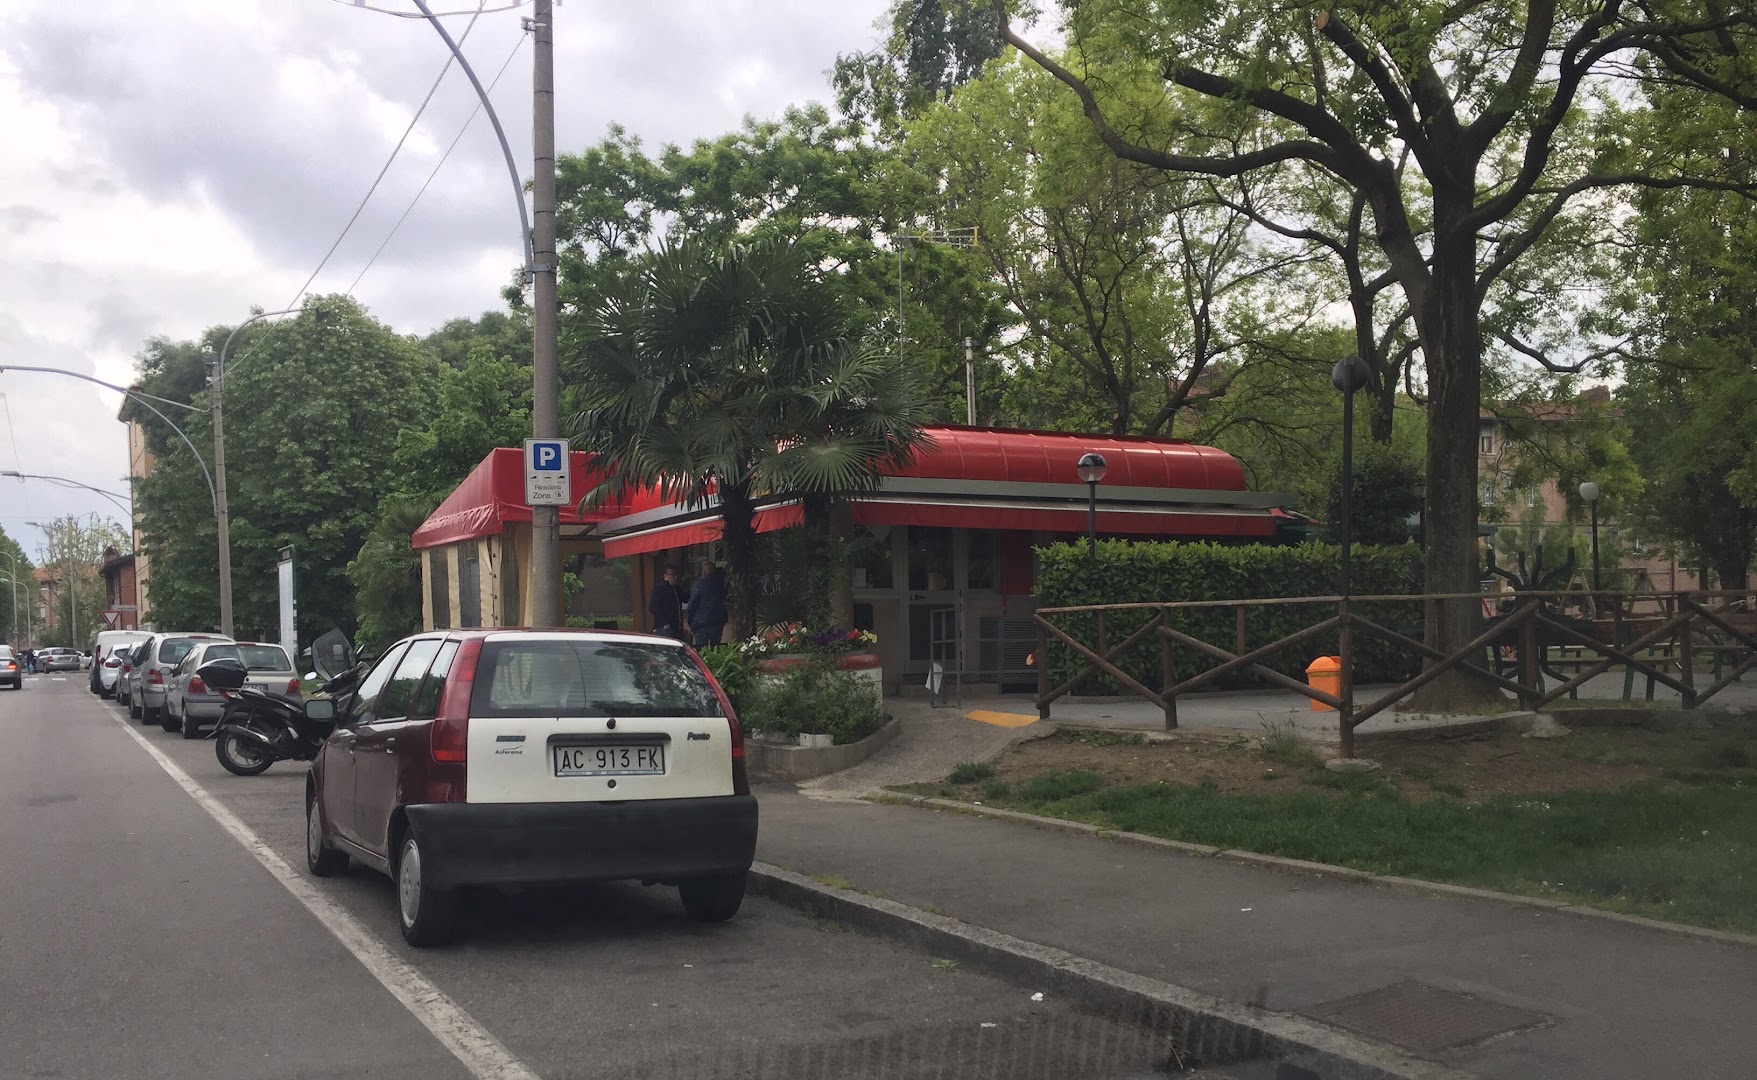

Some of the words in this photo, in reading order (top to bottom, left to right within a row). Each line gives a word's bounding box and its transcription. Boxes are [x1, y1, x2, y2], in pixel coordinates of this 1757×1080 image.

[539, 447, 556, 467] P
[533, 491, 552, 499] Zona
[687, 731, 711, 741] Punto
[562, 749, 584, 769] AC
[596, 749, 630, 768] 913
[637, 748, 659, 768] FK
